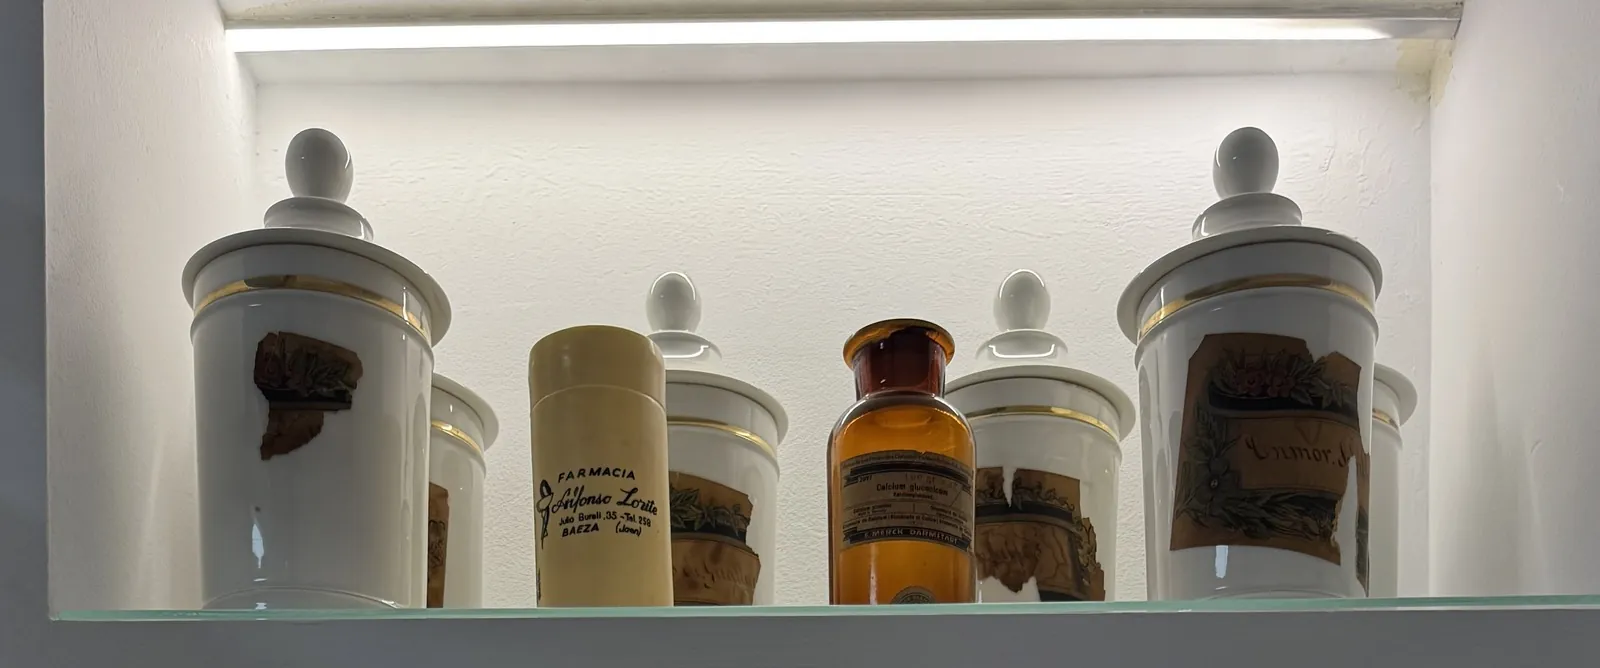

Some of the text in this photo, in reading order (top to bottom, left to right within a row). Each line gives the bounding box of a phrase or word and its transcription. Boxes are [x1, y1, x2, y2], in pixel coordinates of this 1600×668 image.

[558, 467, 635, 483] FARMACIA
[876, 483, 906, 492] Calcium
[551, 485, 658, 515] Alfonso Lorite
[638, 516, 652, 528] 258
[562, 523, 599, 537] BAEZA
